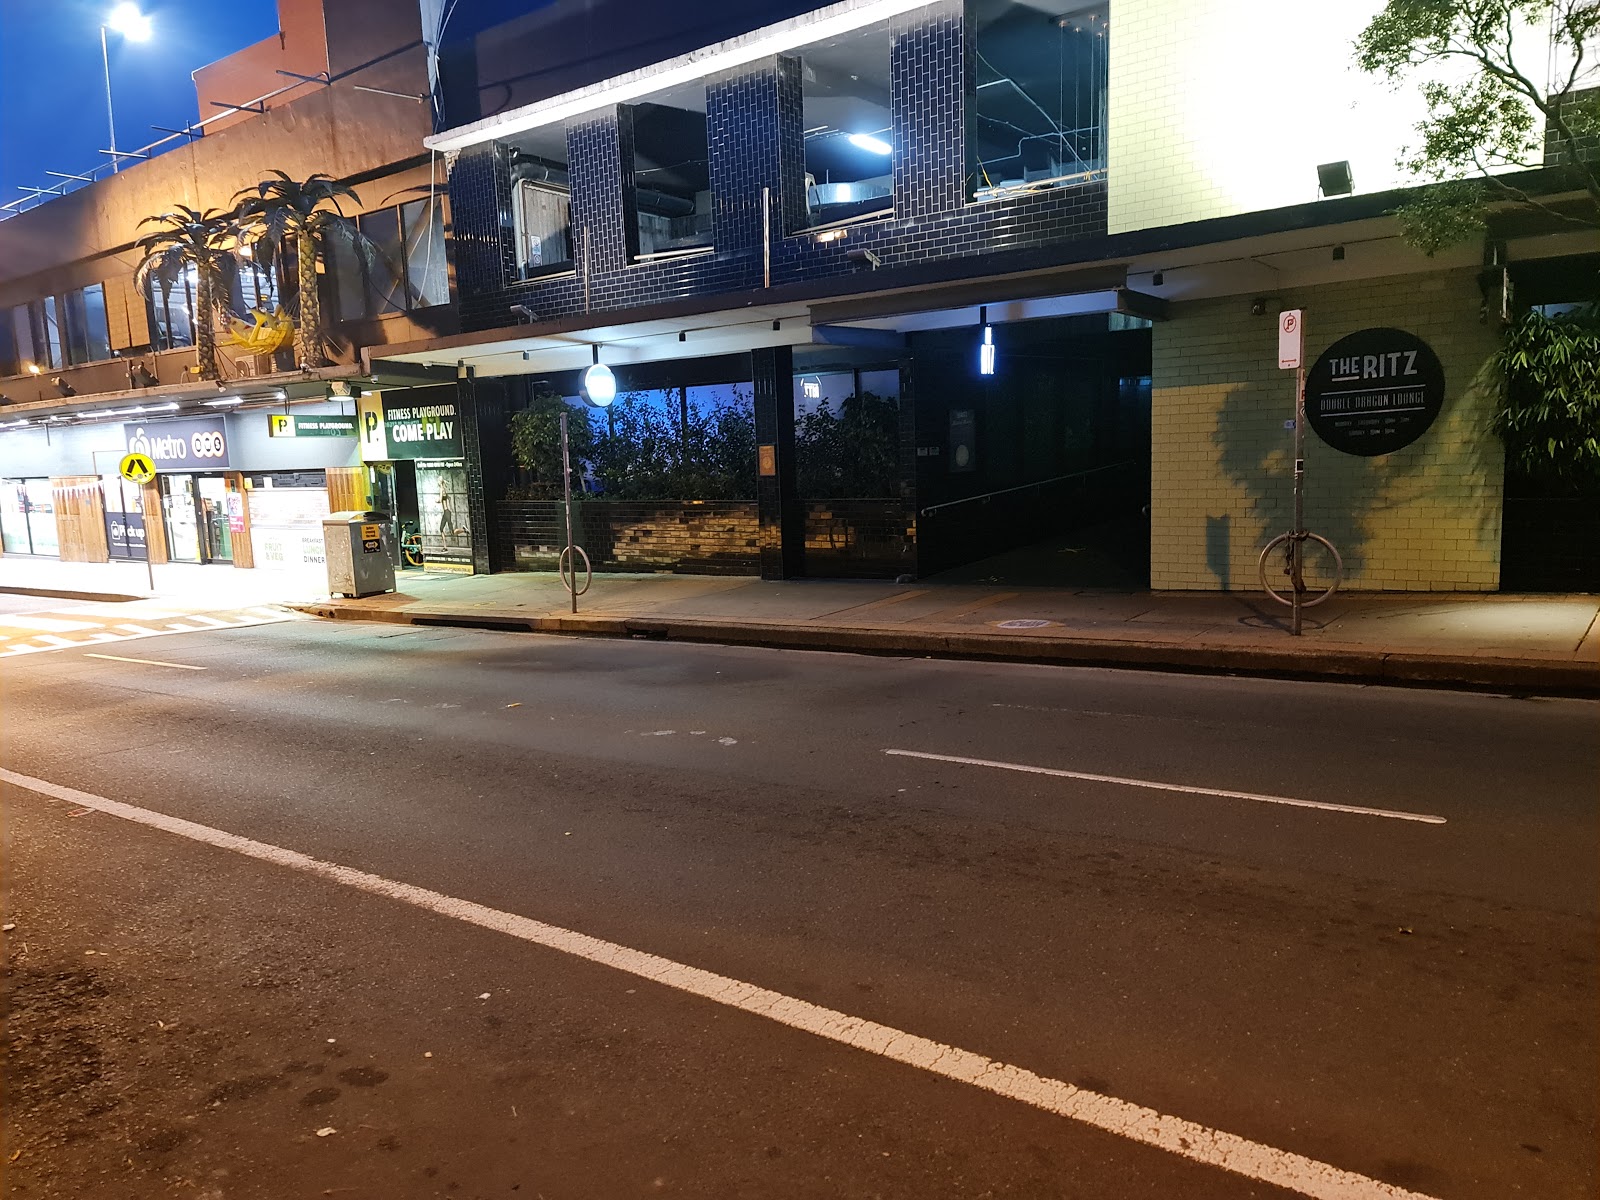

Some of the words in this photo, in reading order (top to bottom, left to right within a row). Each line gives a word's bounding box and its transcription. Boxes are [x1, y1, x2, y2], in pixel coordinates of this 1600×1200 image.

[1329, 356, 1360, 376] THE
[1363, 350, 1418, 379] RITZ
[1320, 397, 1351, 411] DOUBLE
[1355, 393, 1389, 409] DRAGON
[1392, 391, 1425, 406] LOUNGE
[387, 407, 410, 421] FITNESS
[298, 422, 318, 430] FITNESS
[392, 423, 425, 443] COME
[426, 421, 454, 441] PLAY
[151, 434, 187, 460] Metro
[136, 528, 145, 540] up
[264, 542, 282, 552] FRUIT
[303, 545, 325, 555] LUNCH
[304, 555, 326, 564] DINNER
